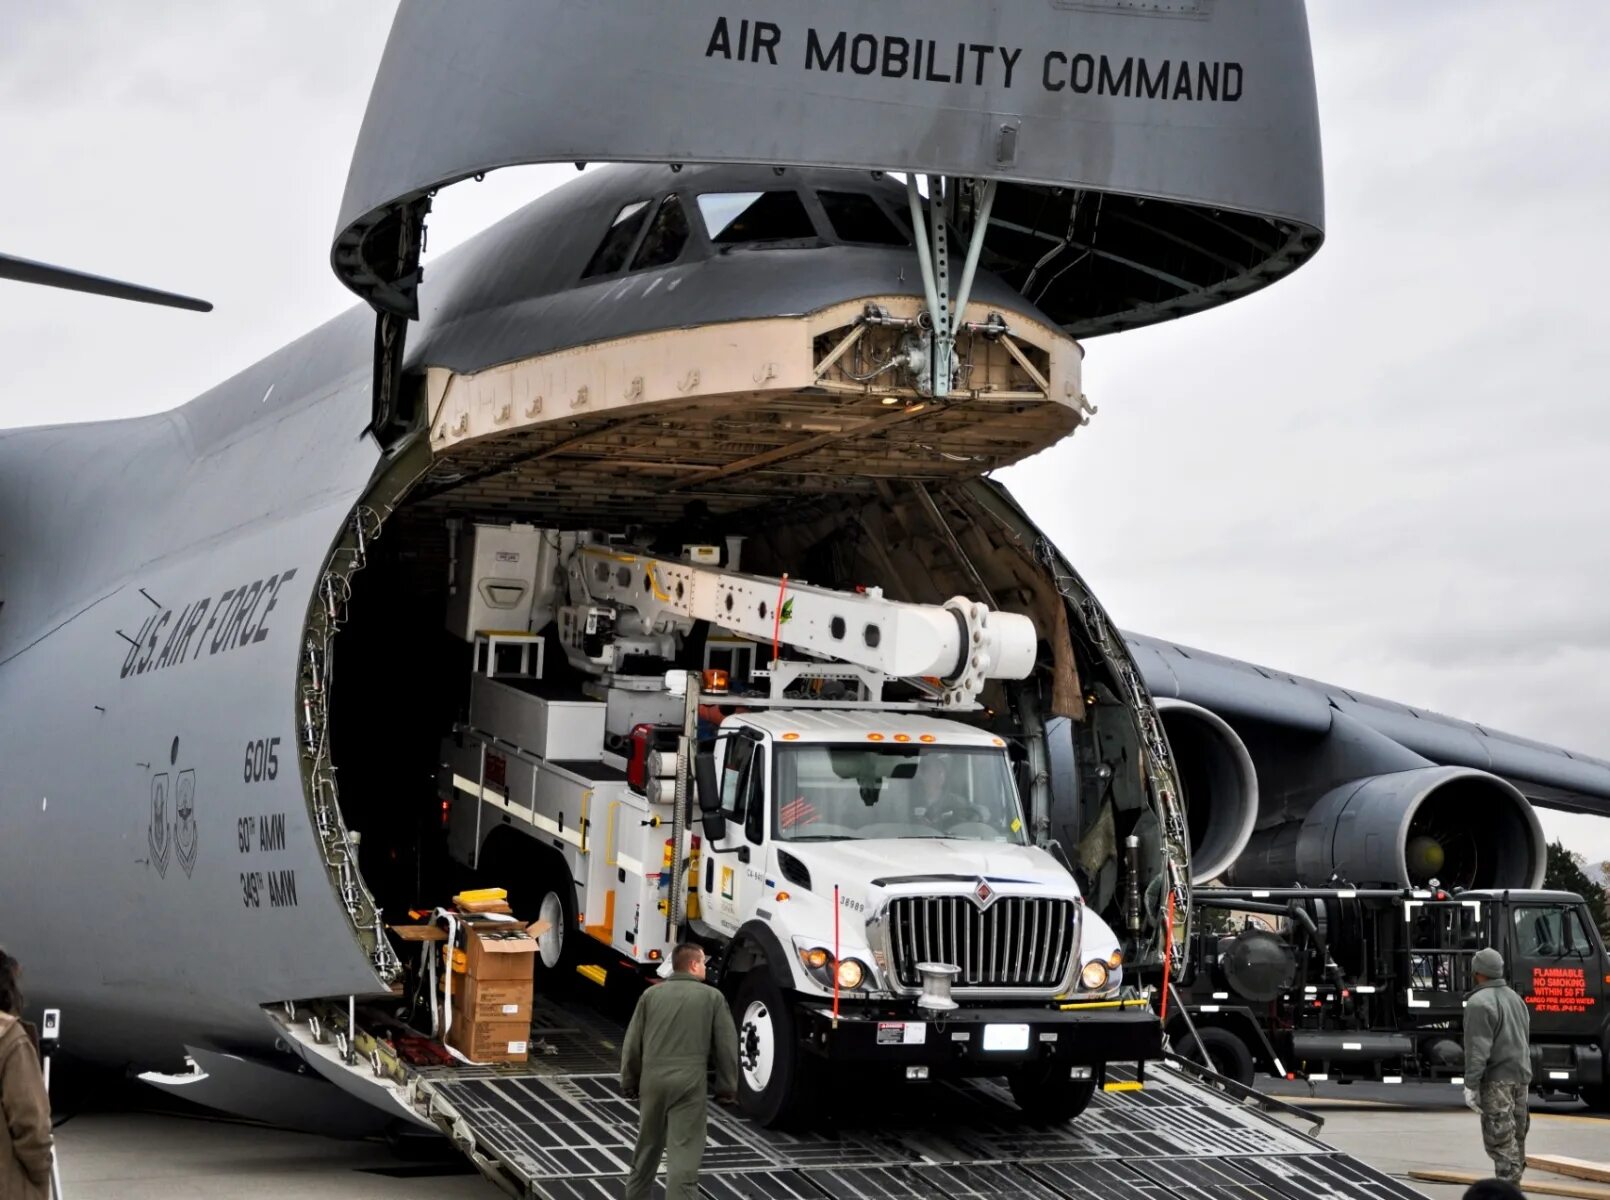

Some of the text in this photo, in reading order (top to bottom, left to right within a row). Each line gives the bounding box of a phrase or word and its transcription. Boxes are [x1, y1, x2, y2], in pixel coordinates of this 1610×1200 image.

[705, 16, 1244, 102] AIR MOBILITY COMMAND
[154, 597, 212, 671] AIR
[193, 567, 299, 660] FORCE
[243, 736, 281, 783] 6015
[259, 813, 286, 851] AMW
[267, 869, 298, 907] AMW
[840, 895, 865, 913] 38989
[1533, 968, 1584, 977] FLAMMABLE
[1533, 978, 1585, 987] NO SMOKING
[1534, 987, 1585, 997] WITHIN 50 FT
